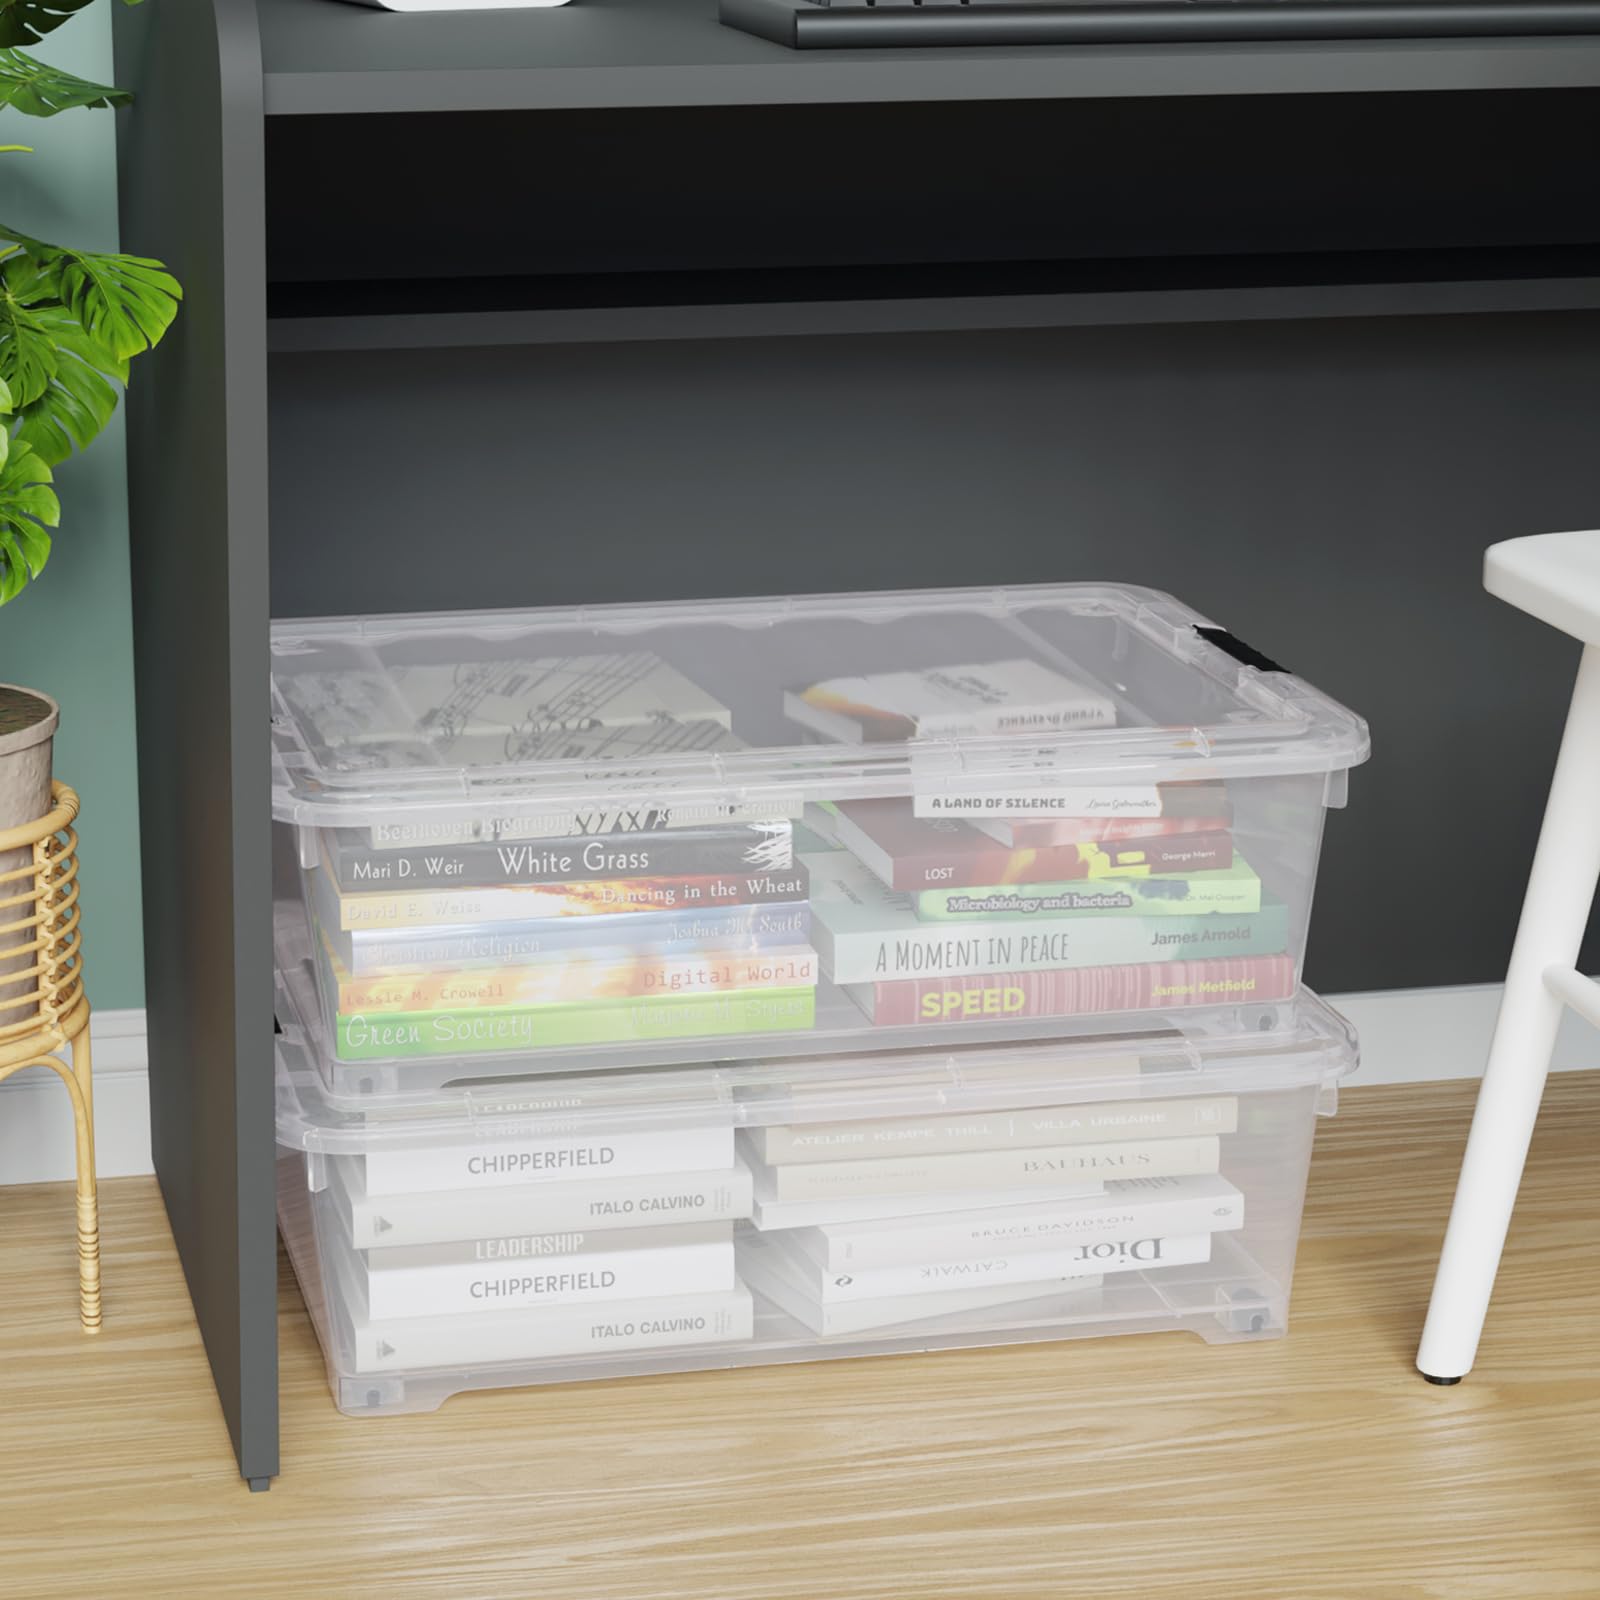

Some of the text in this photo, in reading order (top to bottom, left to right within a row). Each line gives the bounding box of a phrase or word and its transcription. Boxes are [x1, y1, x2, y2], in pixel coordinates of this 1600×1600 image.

[931, 797, 1066, 808] A LAND OF SILENCE
[353, 857, 465, 879] Mari D. Weir
[497, 842, 649, 875] White Grass
[925, 866, 954, 880] LOST
[600, 876, 803, 905] Dancing in the Wheat
[947, 892, 1131, 912] Microbiology and bacteria
[1152, 926, 1251, 945] James Arnold
[875, 933, 1069, 972] A MOMENT IN PEACE
[643, 962, 811, 989] Digital World
[439, 983, 505, 1001] Crowell
[920, 987, 1025, 1018] SPEED
[346, 1011, 533, 1048] Green Society
[1032, 1111, 1168, 1131] VILLA URBAINE
[791, 1123, 993, 1146] ATELIER KEMPE THILL
[467, 1146, 615, 1174] CHIPPERFIELD
[590, 1200, 634, 1216] ITALO
[639, 1194, 705, 1212] CALVINO
[1037, 1215, 1135, 1232] DAVIDSON
[475, 1233, 584, 1260] LEADERSHIP
[921, 1237, 1166, 1279] Dior CATWALK
[469, 1271, 616, 1299] CHIPPERFIELD
[591, 1322, 634, 1339] ITALO
[640, 1317, 706, 1334] CALVINO
